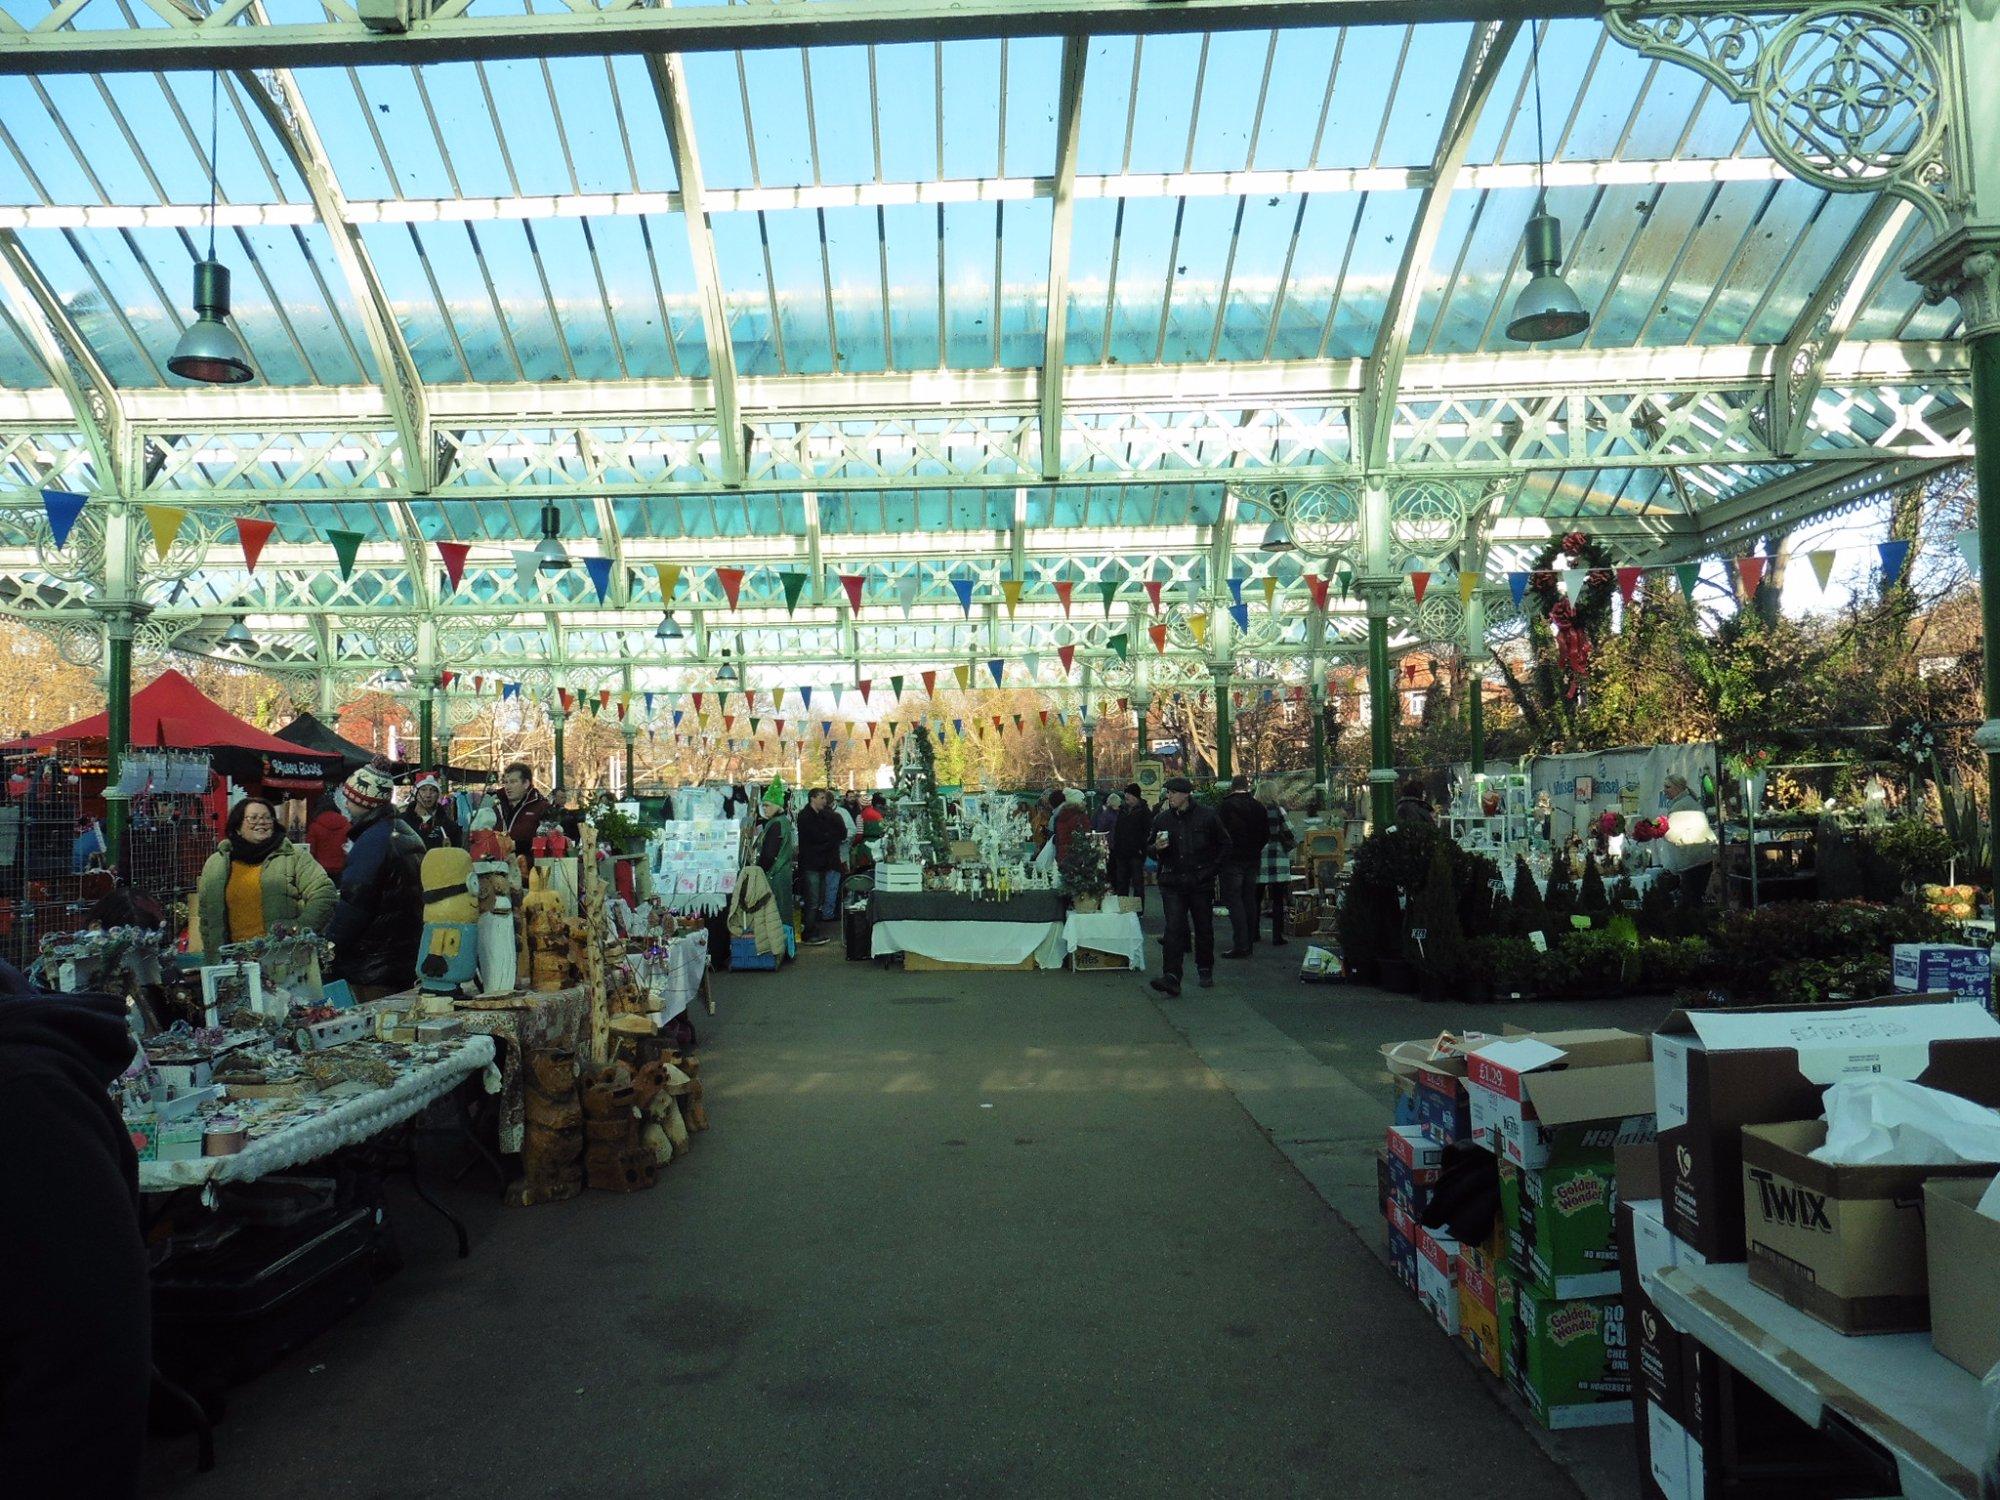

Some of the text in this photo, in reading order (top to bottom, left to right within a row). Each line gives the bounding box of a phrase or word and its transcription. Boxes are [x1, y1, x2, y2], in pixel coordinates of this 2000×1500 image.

[1479, 1063, 1503, 1086] £1.29
[1557, 1179, 1598, 1199] Golden
[1559, 1190, 1602, 1210] Wonder
[1551, 1306, 1592, 1327] Golden
[1604, 1305, 1625, 1322] RO
[1553, 1318, 1598, 1340] Wonder
[1603, 1321, 1627, 1347] CU
